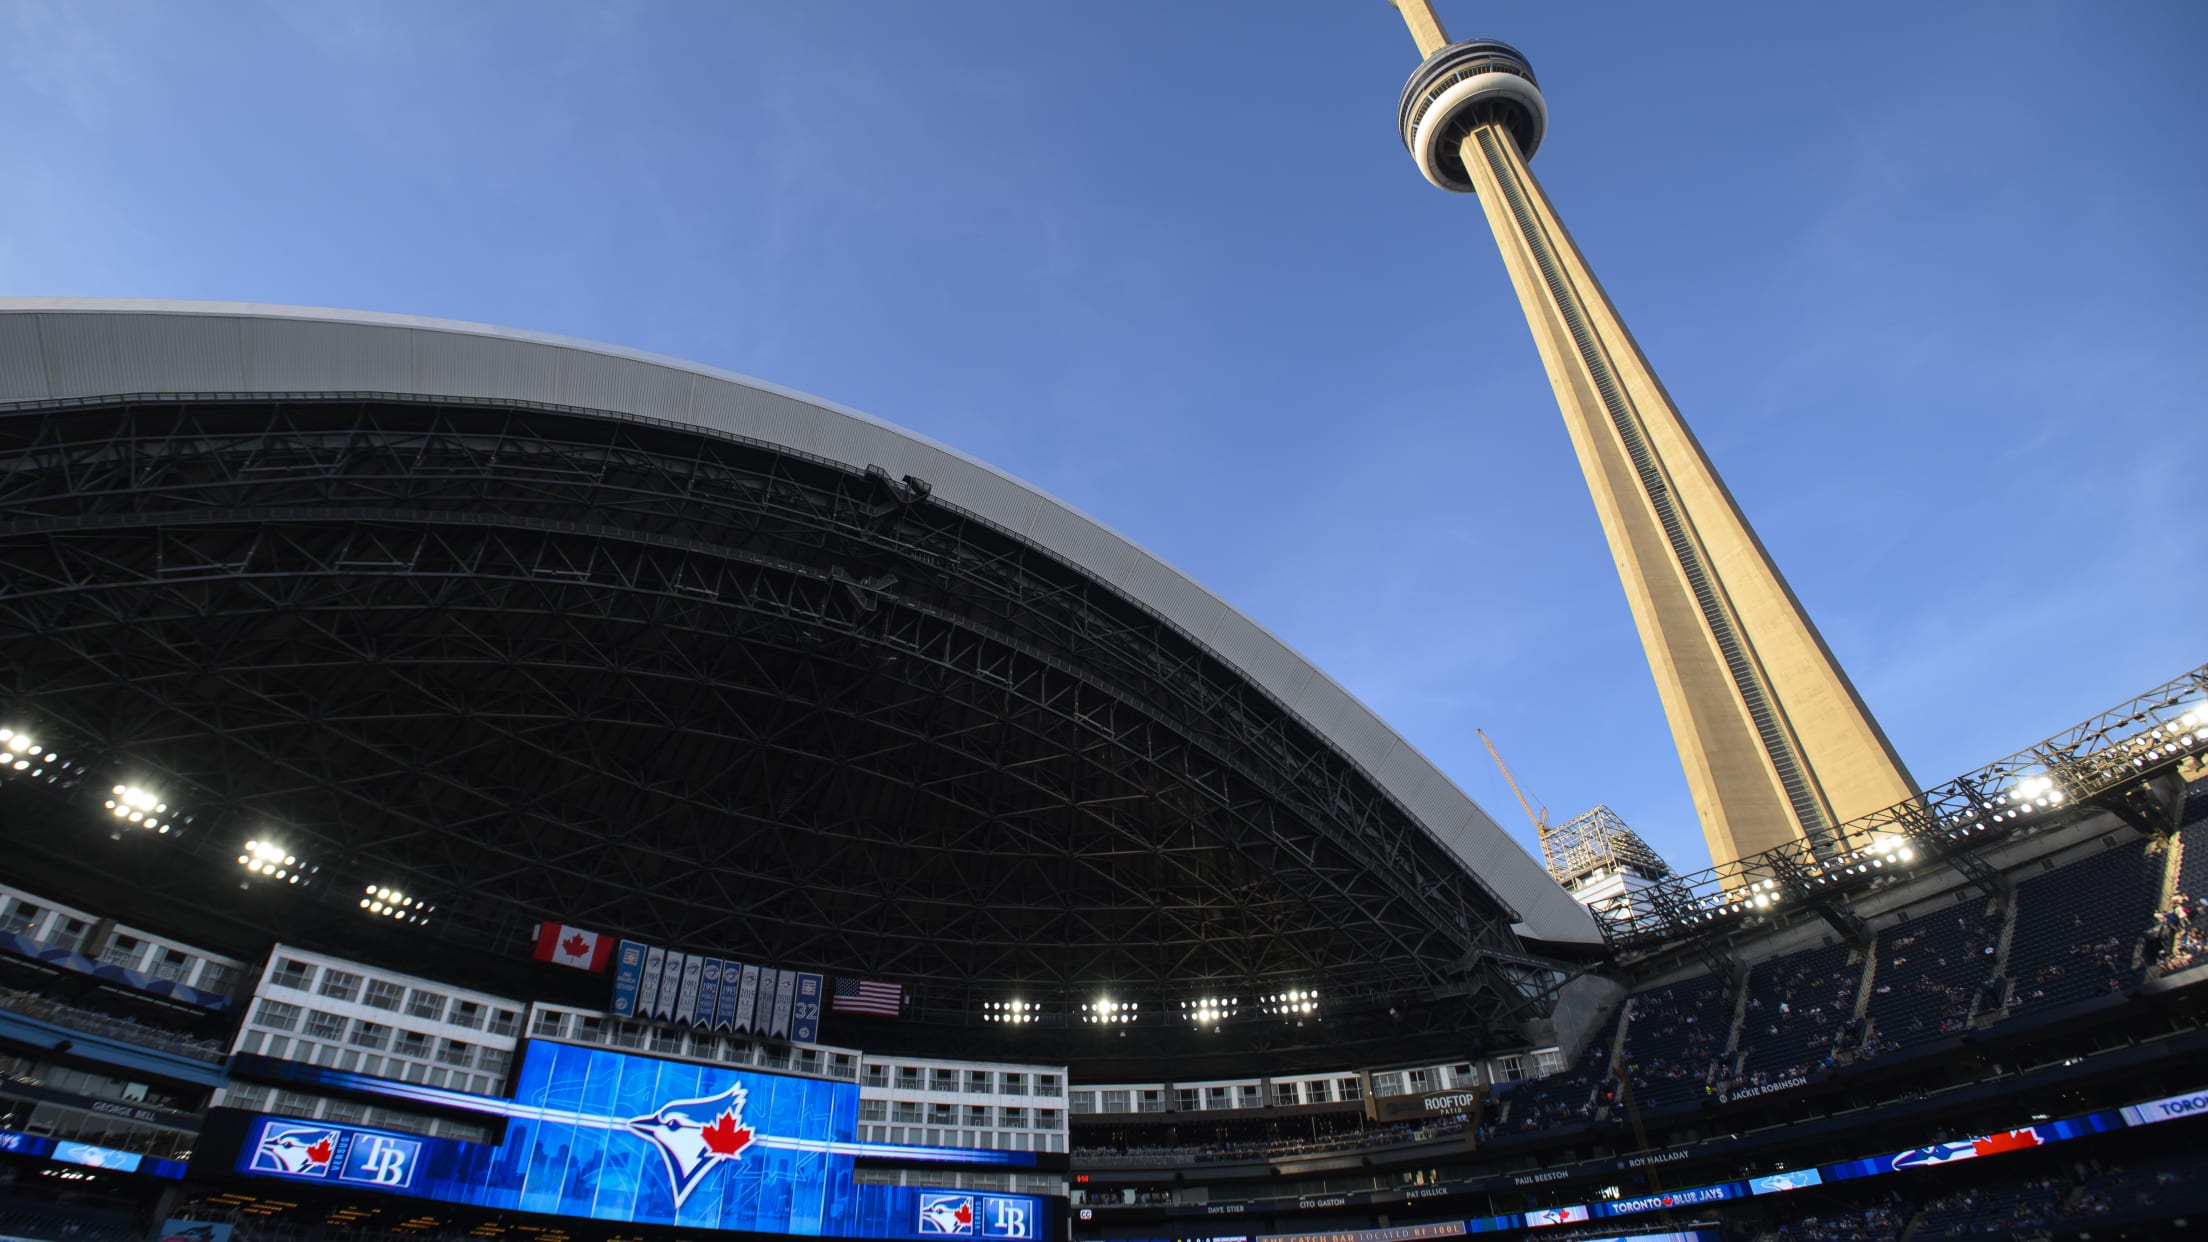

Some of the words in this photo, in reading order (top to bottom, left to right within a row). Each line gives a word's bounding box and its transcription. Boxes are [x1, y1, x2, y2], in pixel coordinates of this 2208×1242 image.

[795, 1002, 818, 1020] 32
[1731, 1087, 1760, 1101] JACKIE
[1760, 1076, 1807, 1095] ROBINSON
[92, 1101, 133, 1117] GEORGE
[134, 1110, 156, 1121] BELL
[1424, 1094, 1473, 1111] ROOFTOP
[1440, 1107, 1462, 1115] PATIO
[2159, 1097, 2208, 1116] TORO
[331, 1137, 350, 1172] VERSUS
[360, 1135, 406, 1185] TB
[1629, 1157, 1645, 1168] ROY
[1647, 1150, 1689, 1165] HALLADAY
[1515, 1175, 1534, 1185] PAUL
[1534, 1169, 1569, 1182] BEESTON
[1406, 1191, 1420, 1199] PAT
[1421, 1187, 1448, 1198] GILLICK
[1612, 1197, 1662, 1213] TORONTO
[1673, 1192, 1698, 1204] BLUE
[1700, 1187, 1724, 1201] JAYS
[1208, 1206, 1224, 1214] DAVE
[1317, 1198, 1345, 1207] GASTON
[990, 1199, 1025, 1237] TB
